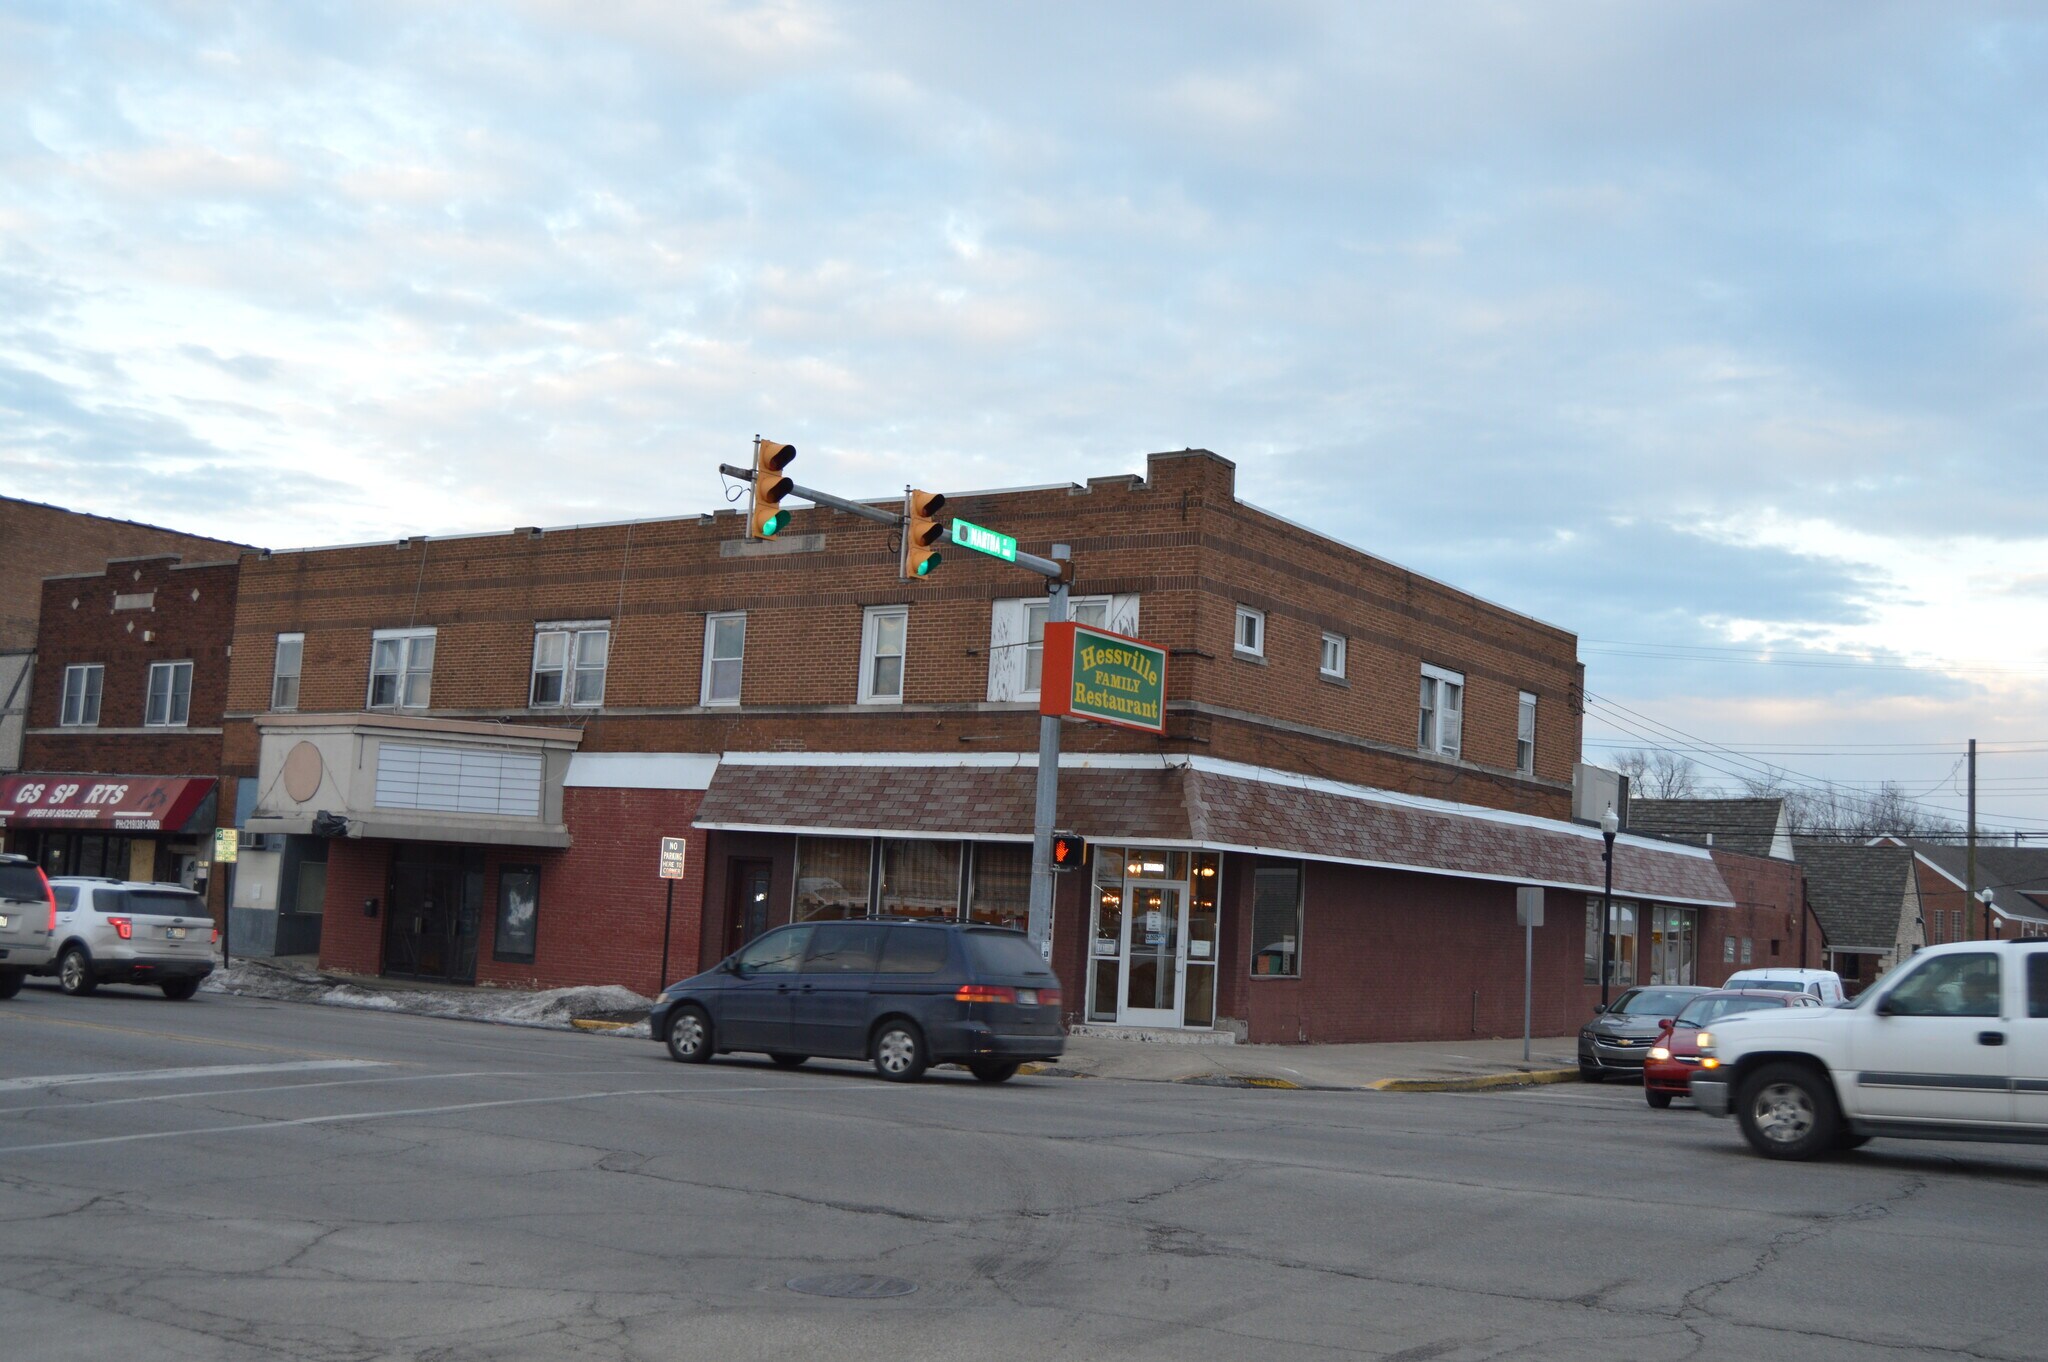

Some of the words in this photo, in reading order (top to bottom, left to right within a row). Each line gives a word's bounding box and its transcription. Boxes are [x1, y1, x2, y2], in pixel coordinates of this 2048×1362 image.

[1081, 645, 1157, 686] Hessville
[1095, 670, 1141, 693] FAMILY
[1075, 682, 1157, 718] Restaurant
[16, 783, 46, 804] GS
[27, 808, 48, 817] UPPER
[54, 809, 80, 818] SOCCER
[78, 809, 100, 818] STORE
[669, 841, 678, 850] NO
[663, 851, 683, 861] PARKING
[662, 867, 681, 875] CORNER
